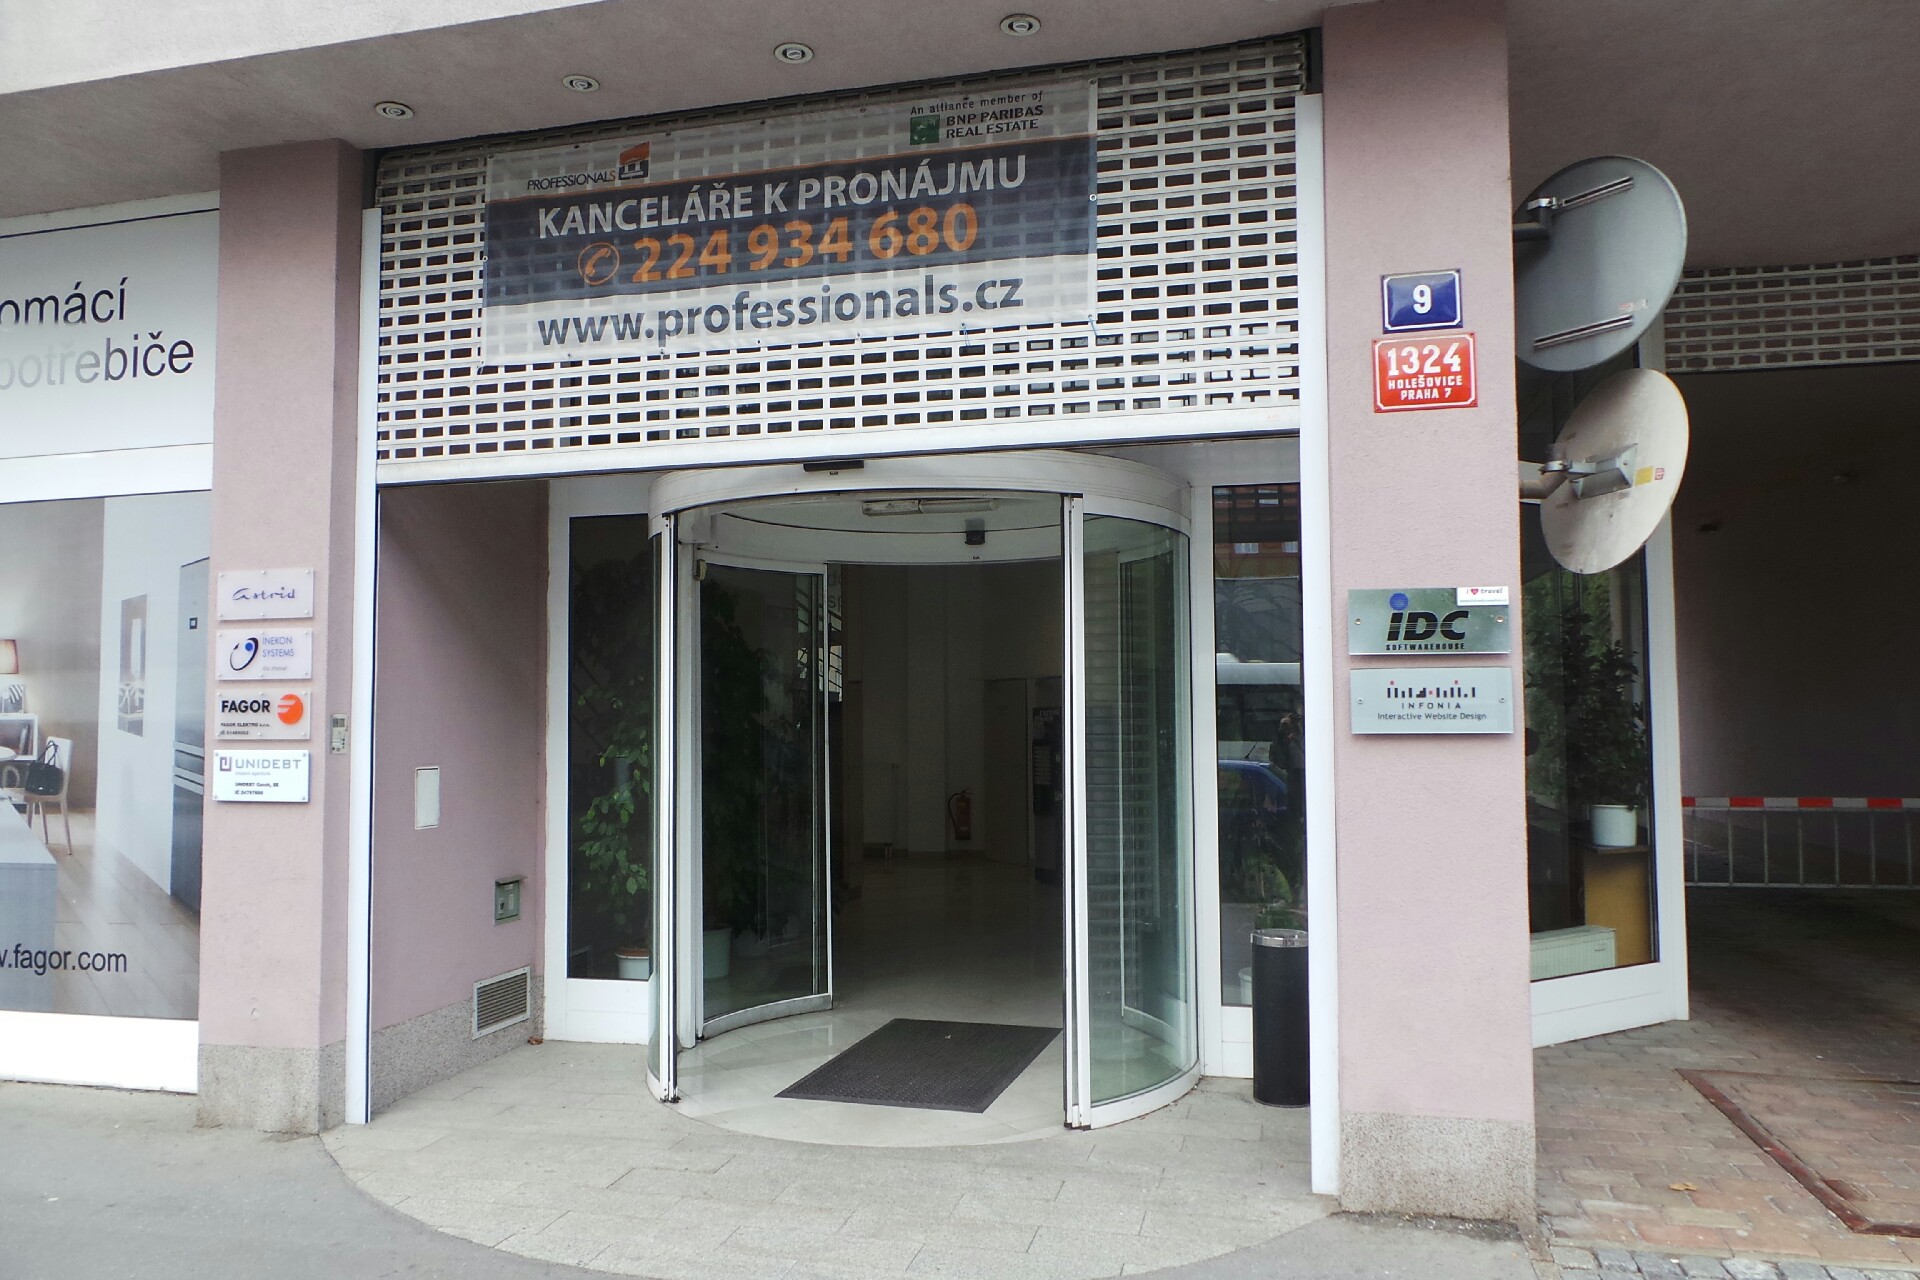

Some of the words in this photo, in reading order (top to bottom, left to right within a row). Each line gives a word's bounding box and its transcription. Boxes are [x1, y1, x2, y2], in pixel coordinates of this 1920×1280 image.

[910, 106, 924, 115] An
[929, 100, 974, 112] alliance
[980, 94, 1026, 107] member
[1032, 91, 1043, 102] of
[946, 114, 977, 126] BNP
[980, 105, 1044, 122] PARIBAS
[946, 125, 983, 139] REAL
[986, 118, 1039, 135] ESTATE
[527, 169, 616, 190] PROFESSIONALS
[538, 182, 753, 239] KANCELÁŘE
[764, 182, 788, 215] K
[798, 155, 1026, 210] PRONÁJMU
[632, 229, 732, 283] 224
[748, 215, 852, 271] 934
[869, 203, 978, 259] 680
[1413, 284, 1432, 314] 9
[537, 274, 1024, 348] www.professionals.cz
[1387, 342, 1461, 376] 1324
[1388, 375, 1463, 390] HOLEŠOVICE
[1401, 388, 1439, 401] PRAHA
[1444, 387, 1452, 399] 7
[262, 636, 293, 645] INEKON
[1385, 643, 1465, 651] SOFTWAREHOUSE
[262, 648, 295, 658] SYSTEMS
[221, 700, 271, 713] FAGOR
[1401, 702, 1461, 710] INFONIA
[1377, 712, 1422, 720] Interactive
[1424, 712, 1458, 720] Website
[1460, 712, 1487, 721] Design
[235, 759, 302, 769] UNIDEBT
